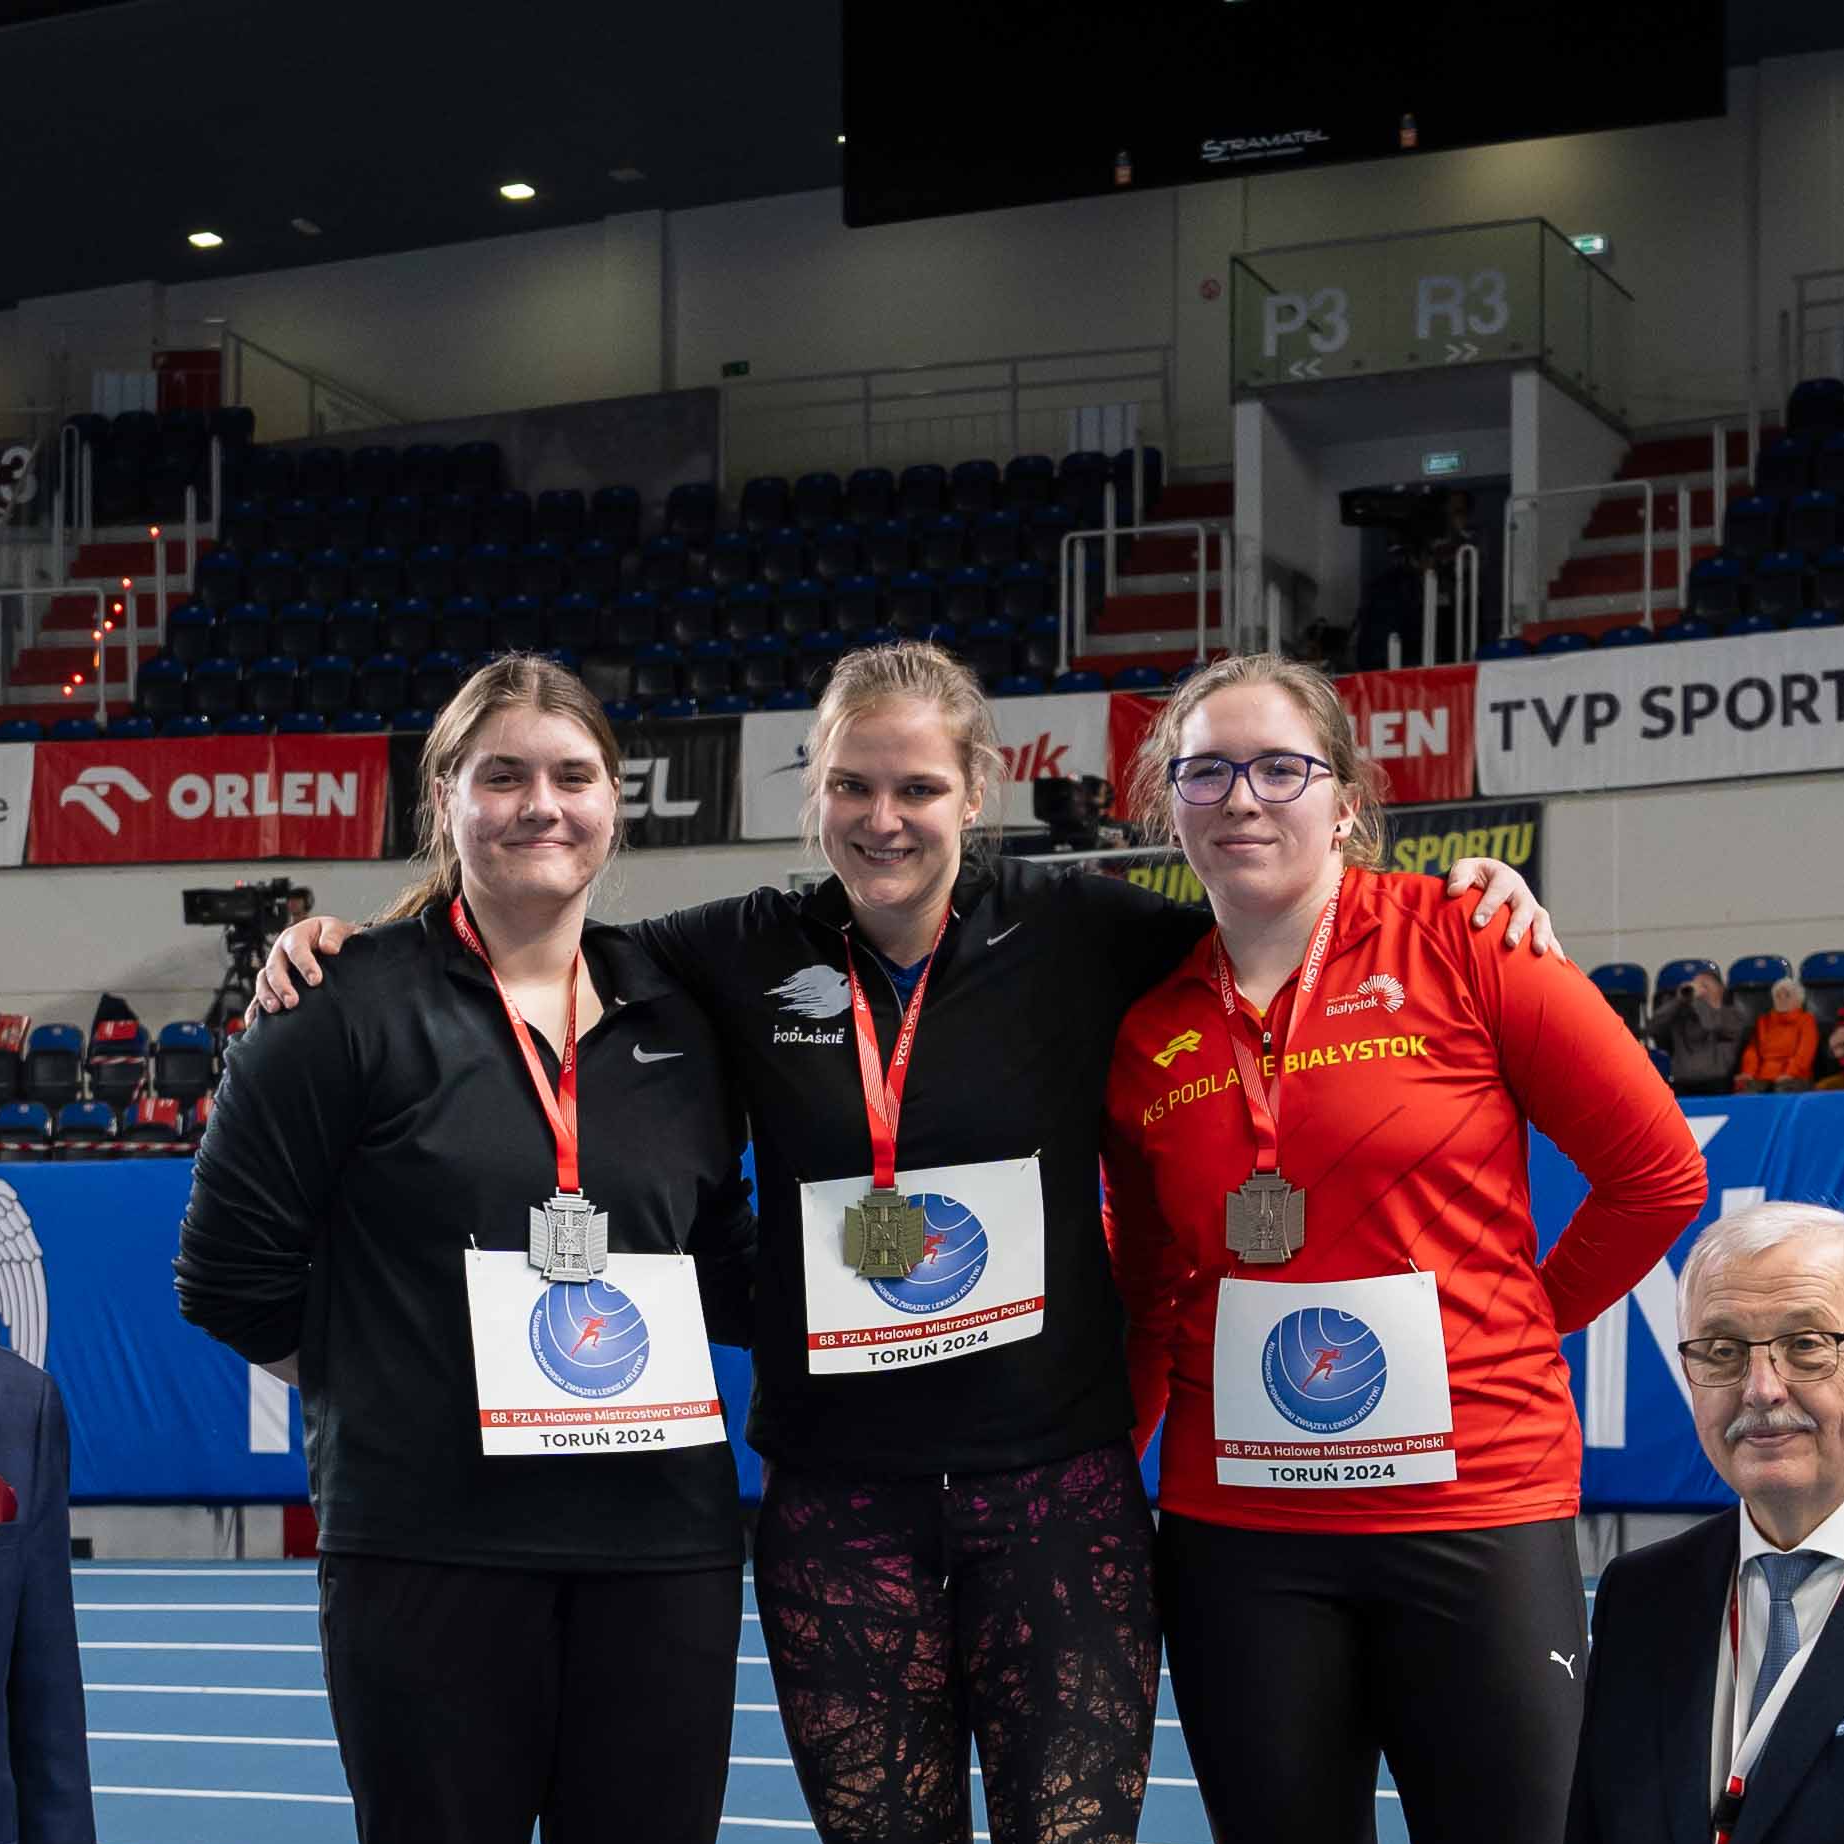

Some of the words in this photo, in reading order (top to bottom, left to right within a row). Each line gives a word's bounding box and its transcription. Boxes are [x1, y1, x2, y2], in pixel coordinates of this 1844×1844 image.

[1201, 129, 1331, 159] STRAMATEL
[1262, 287, 1351, 360] P3
[1414, 269, 1511, 341] R3
[1352, 707, 1449, 759] LEN
[1490, 691, 1622, 752] TVP
[167, 772, 358, 818] ORLEN
[1301, 900, 1338, 993] MISTRZOSTWA
[773, 1031, 844, 1044] PODLASKIE
[1143, 1097, 1164, 1126] KS
[1169, 1056, 1275, 1110] PODLAIE
[1284, 1035, 1428, 1074] BIAŁYSTOK
[819, 1334, 839, 1346] 68.
[842, 1331, 872, 1344] PZLA
[875, 1327, 923, 1341] Halowe
[925, 1312, 998, 1334] Mistrzostwa
[1001, 1300, 1036, 1318] Polski
[868, 1338, 938, 1366] TORUŃ
[942, 1330, 990, 1353] 2024
[491, 1412, 510, 1424] 68.
[513, 1412, 542, 1423] PZLA
[545, 1411, 592, 1423] Halowe
[595, 1406, 670, 1421] Mistrzostwa
[673, 1403, 710, 1416] Polski
[540, 1428, 610, 1448] TORUŃ
[615, 1428, 666, 1444] 2024
[1224, 1443, 1242, 1455] 68.
[1244, 1444, 1272, 1457] PZLA
[1274, 1445, 1321, 1457] Halowe
[1324, 1441, 1403, 1456] Mistrzostwa
[1406, 1436, 1445, 1450] Polski
[1268, 1462, 1339, 1482] TORUŃ
[1343, 1463, 1396, 1481] 2024
